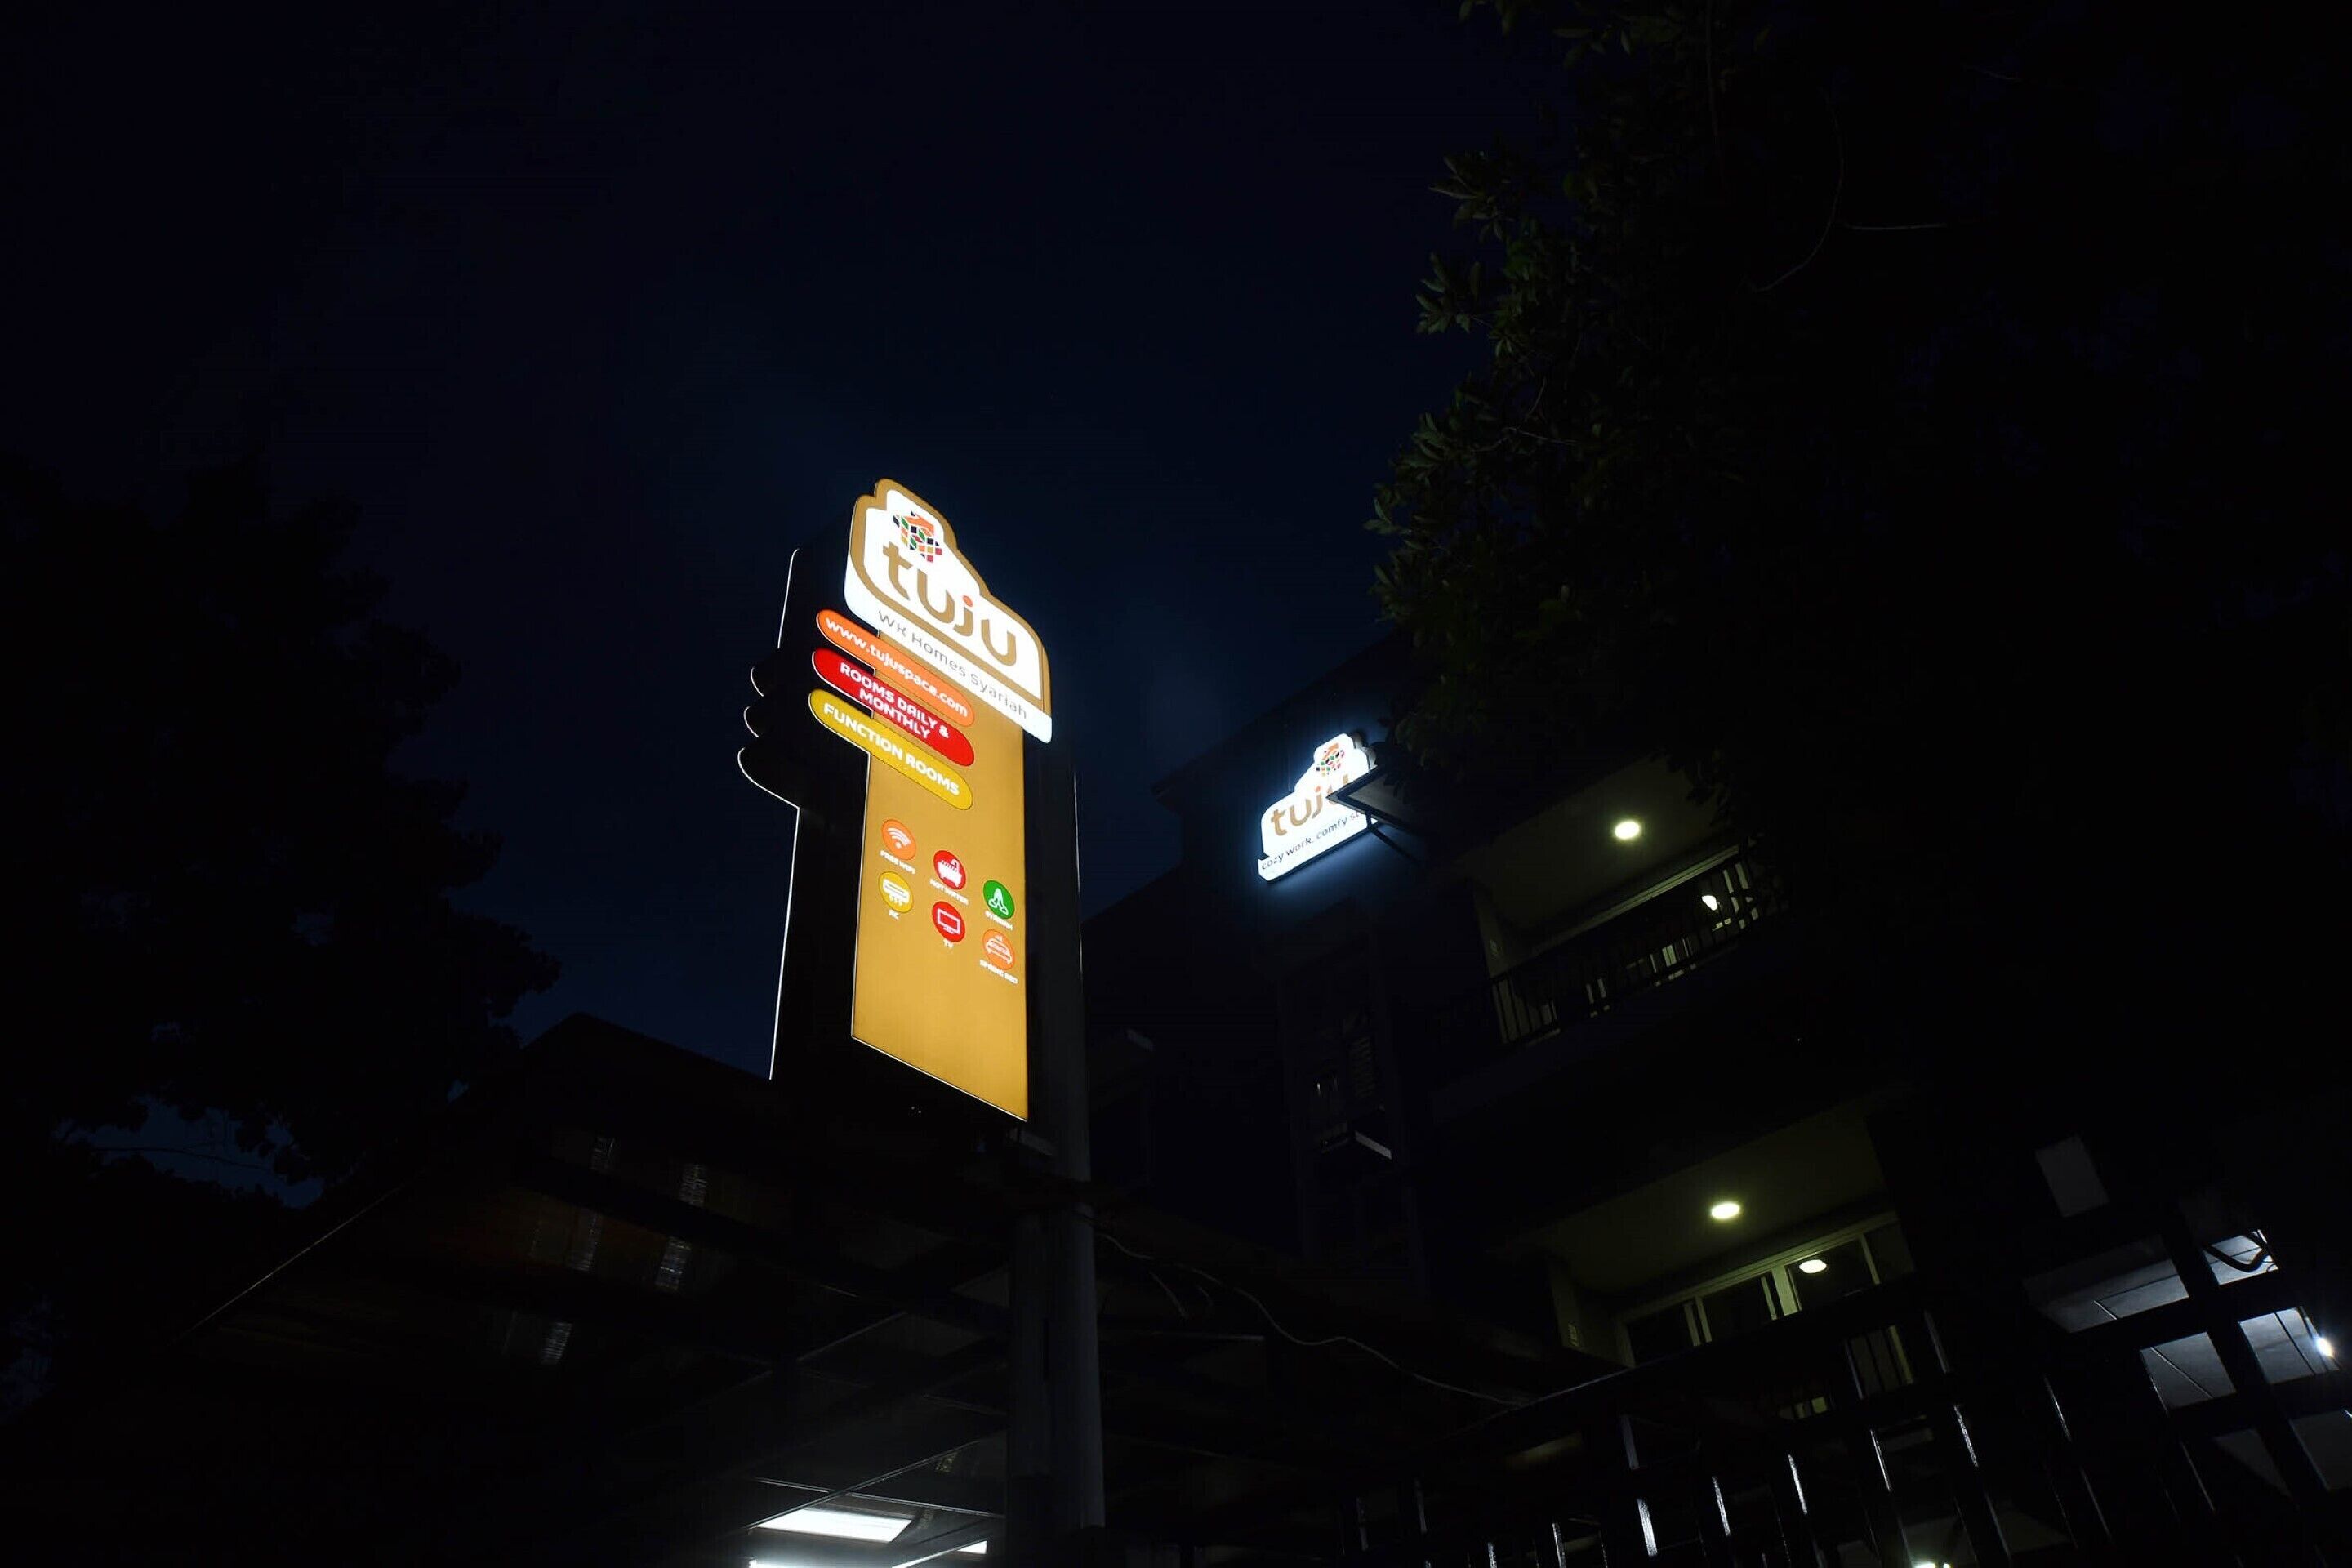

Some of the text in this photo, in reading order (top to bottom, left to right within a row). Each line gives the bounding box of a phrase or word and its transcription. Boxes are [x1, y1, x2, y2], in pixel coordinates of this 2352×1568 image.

[883, 541, 1017, 666] tuju
[825, 617, 969, 718] www.tujuspace.com
[840, 662, 950, 739] ROOMS DAILY &
[911, 632, 966, 677] Homes
[970, 672, 1027, 719] Syariah
[822, 702, 961, 797] FUNCTION ROOMS
[859, 688, 931, 740] MONTHLY
[1261, 853, 1284, 870] cozy
[1316, 816, 1348, 840] comfy
